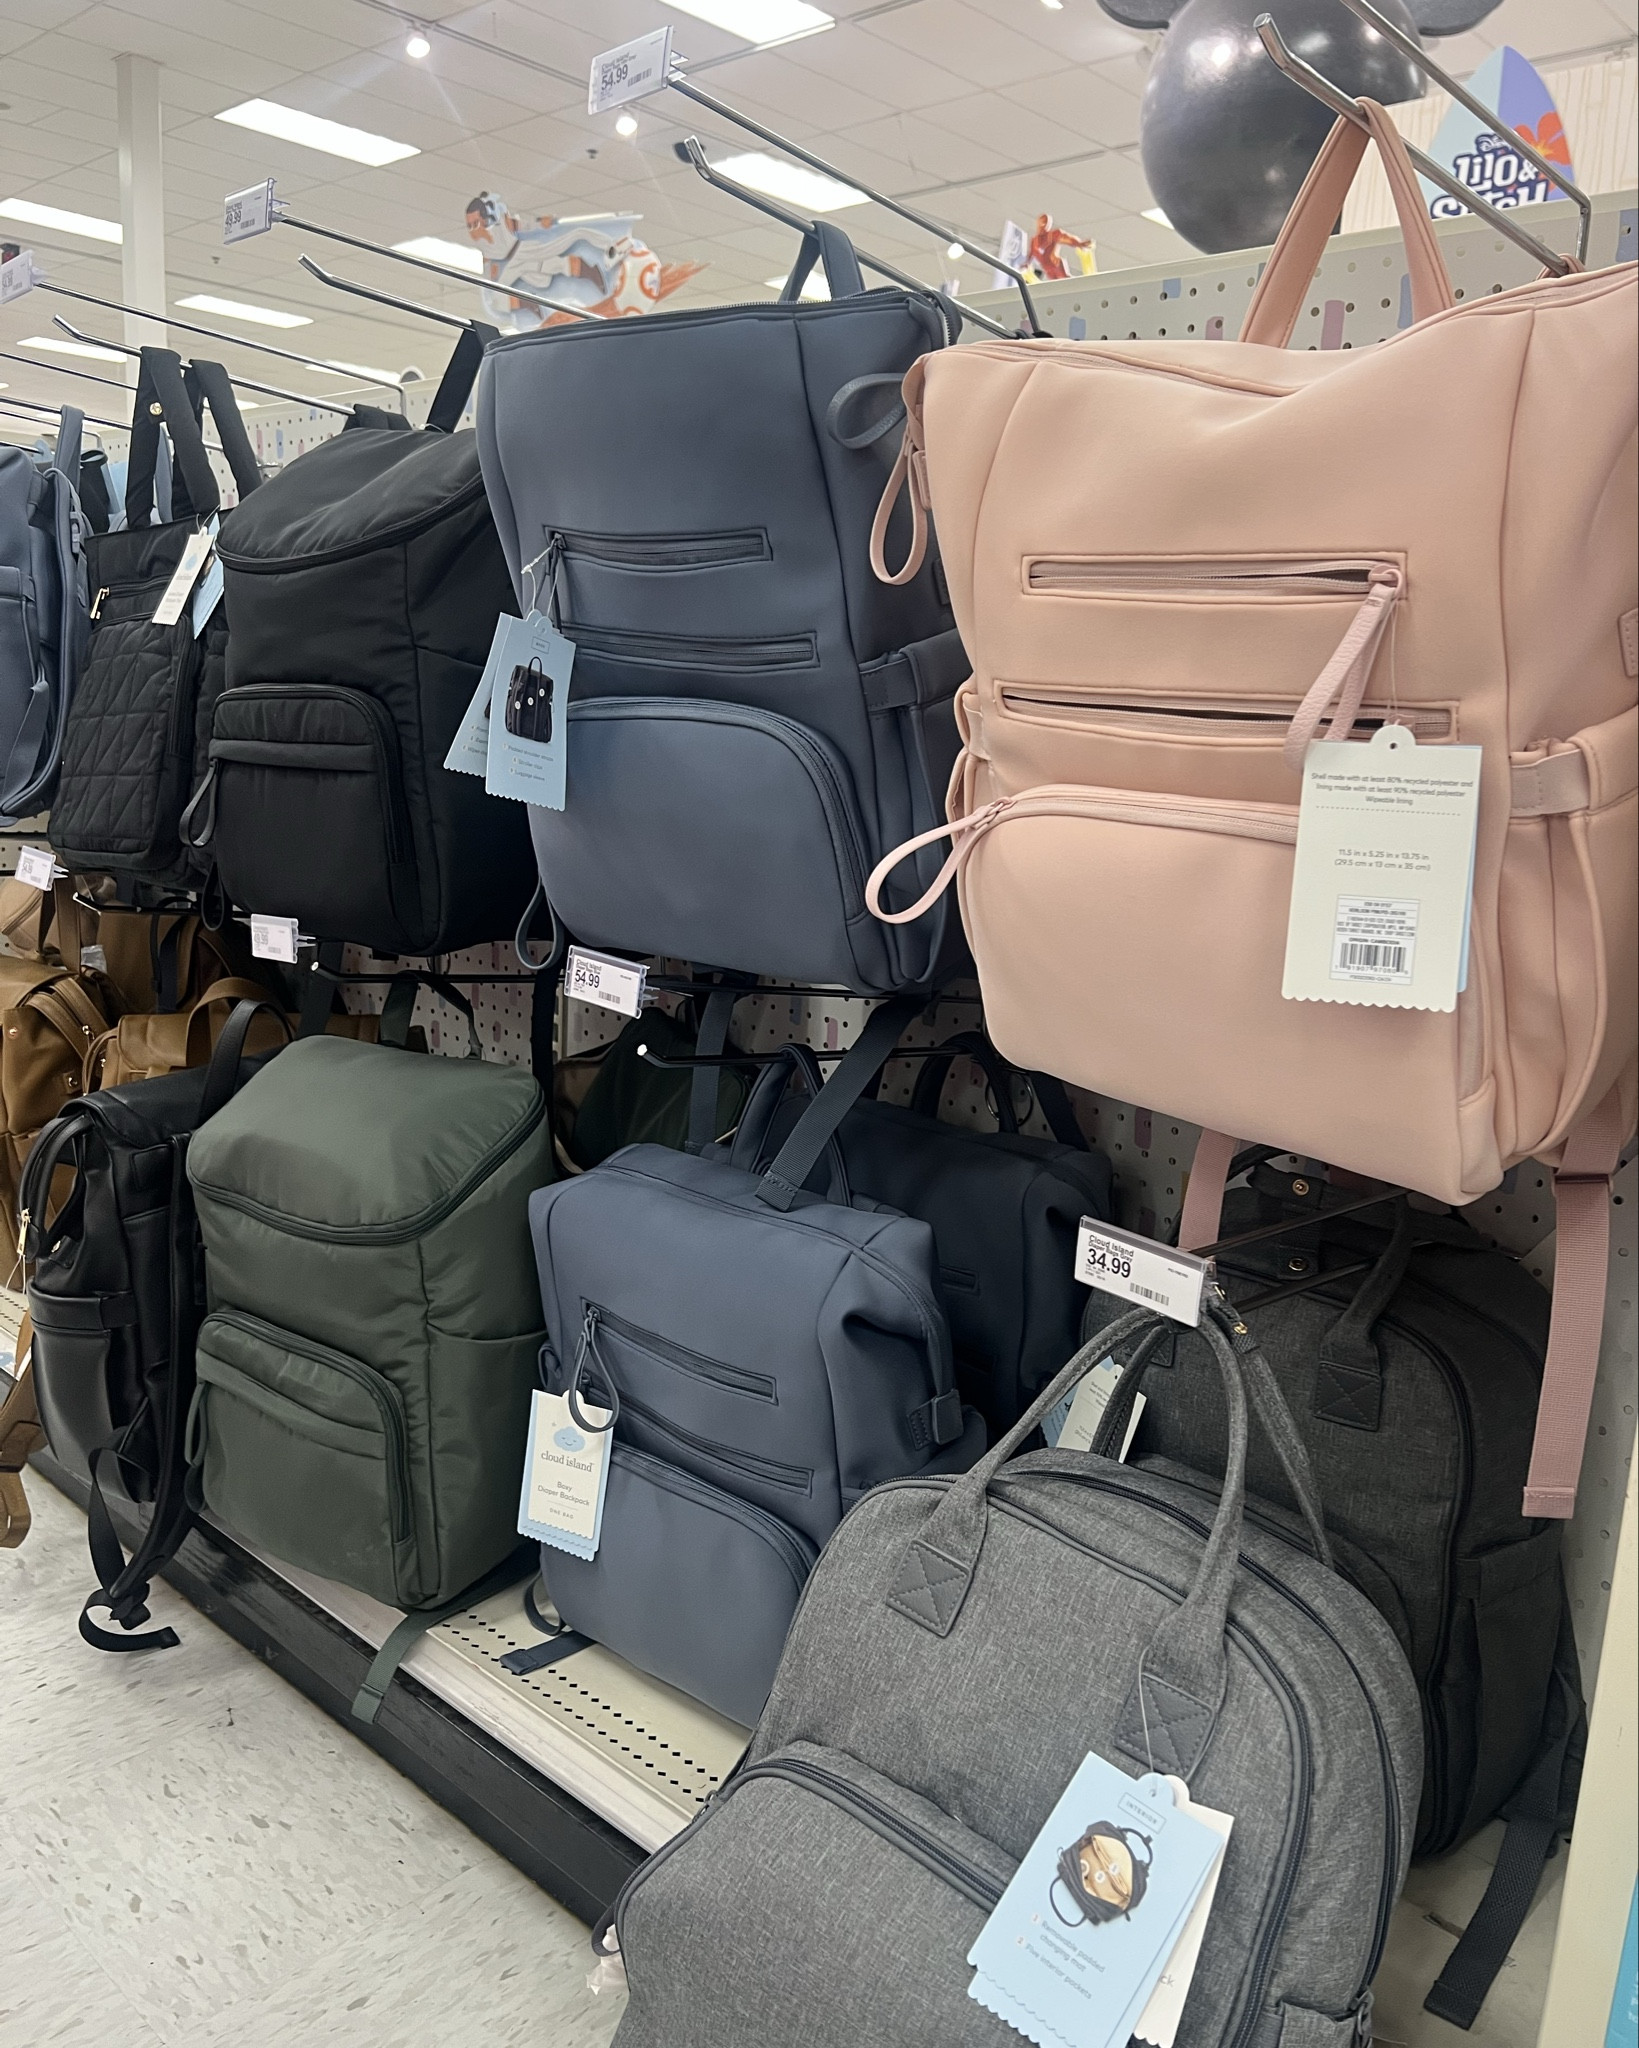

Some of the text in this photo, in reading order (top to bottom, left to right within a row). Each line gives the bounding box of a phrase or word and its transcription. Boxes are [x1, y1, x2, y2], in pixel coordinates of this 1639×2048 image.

[602, 64, 628, 90] 54.99
[1316, 783, 1333, 791] lining
[1436, 789, 1466, 797] polyester
[1430, 779, 1459, 787] polyester
[1396, 797, 1413, 806] lining
[1334, 858, 1353, 866] (29.5
[1375, 860, 1383, 868] 13
[1404, 862, 1414, 870] 35
[1401, 852, 1420, 860] 13.75
[575, 969, 600, 989] 54.99
[1089, 1234, 1135, 1257] Cloud Island
[1087, 1248, 1131, 1278] 34.99
[541, 1450, 593, 1473] cloud island
[537, 1485, 590, 1506] Diaper Backpack
[557, 1481, 573, 1492] Boxy
[549, 1508, 561, 1516] ONE
[1126, 1801, 1157, 1825] INTERIOR
[1040, 1934, 1087, 1972] changing mat
[1041, 1920, 1078, 1952] Removable
[1077, 1950, 1106, 1973] padded
[1040, 1955, 1065, 1977] interior
[1064, 1976, 1092, 2000] pockets
